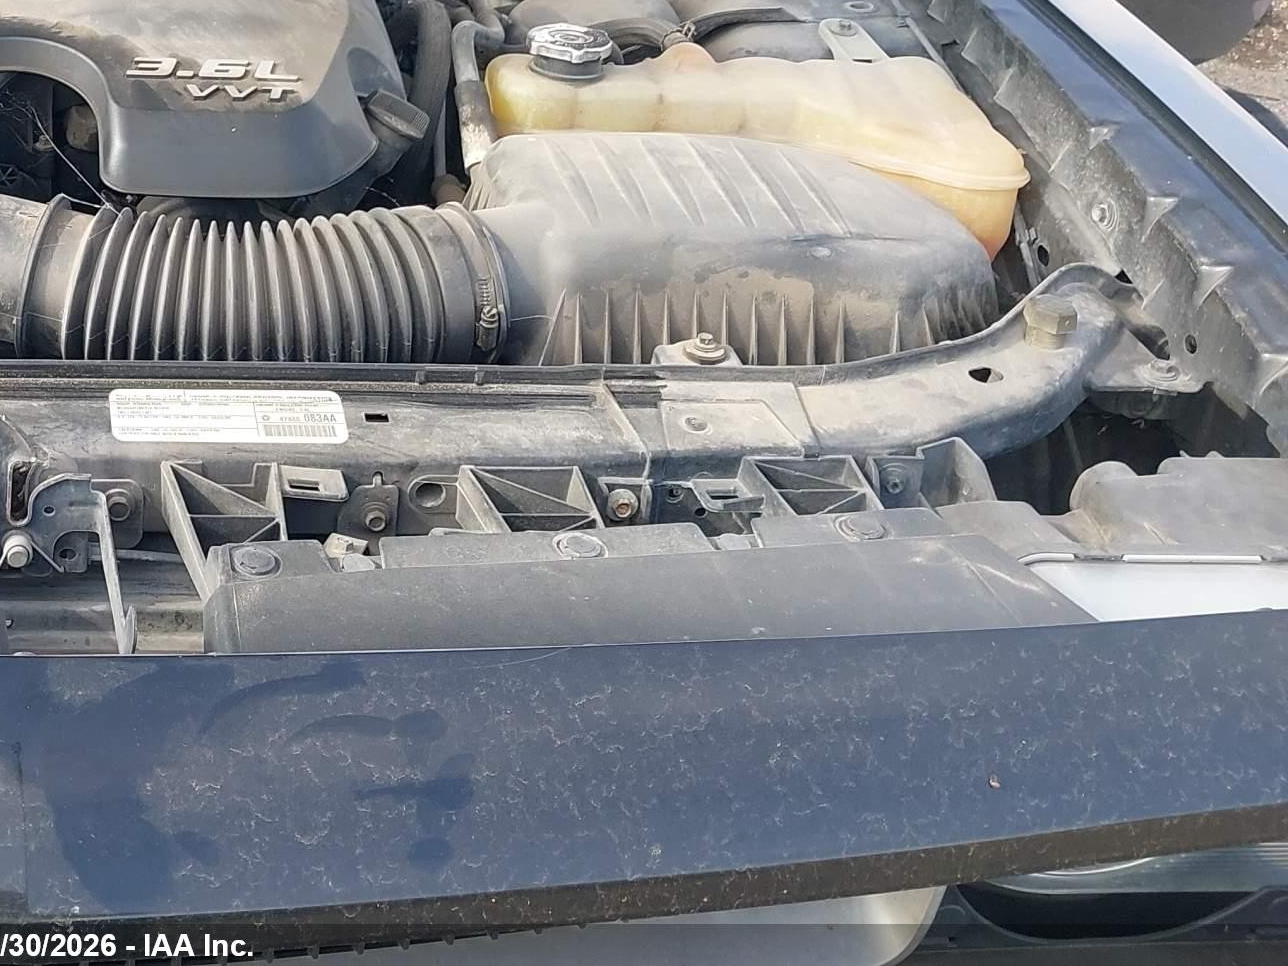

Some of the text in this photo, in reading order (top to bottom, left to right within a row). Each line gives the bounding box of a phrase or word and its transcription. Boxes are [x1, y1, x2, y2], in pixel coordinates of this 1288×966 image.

[125, 56, 302, 82] 3.6L
[186, 84, 297, 102] VVT
[303, 413, 337, 423] 083AA
